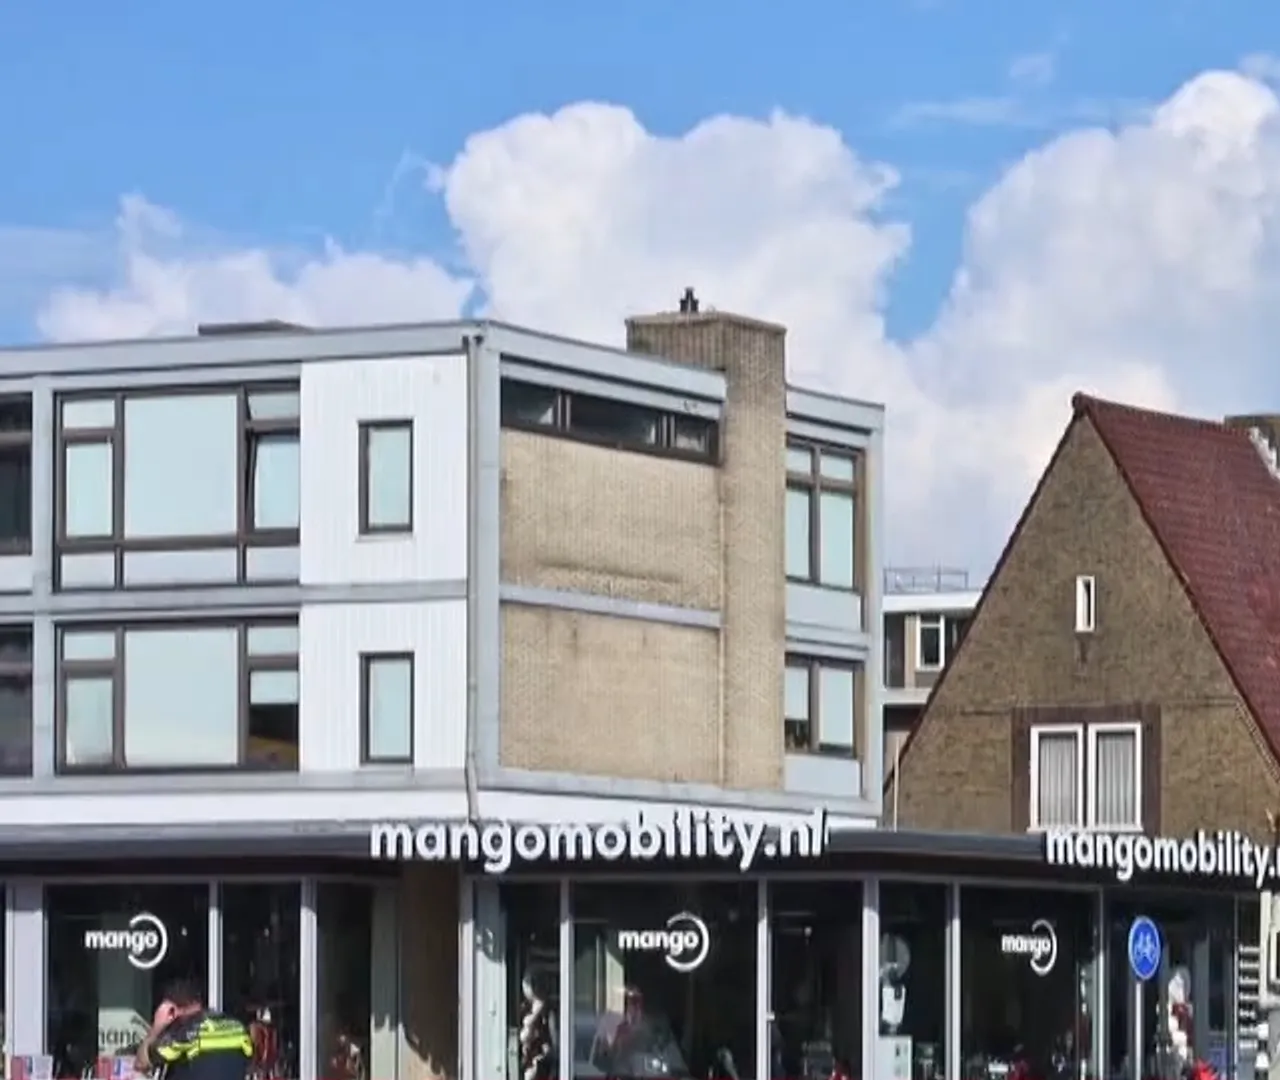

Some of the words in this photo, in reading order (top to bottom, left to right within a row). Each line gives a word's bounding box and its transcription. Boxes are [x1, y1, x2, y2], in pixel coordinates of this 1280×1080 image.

[370, 808, 826, 872] mangomobility.nl
[85, 930, 158, 954] mango
[619, 929, 698, 956] mango
[1002, 933, 1051, 958] mango
